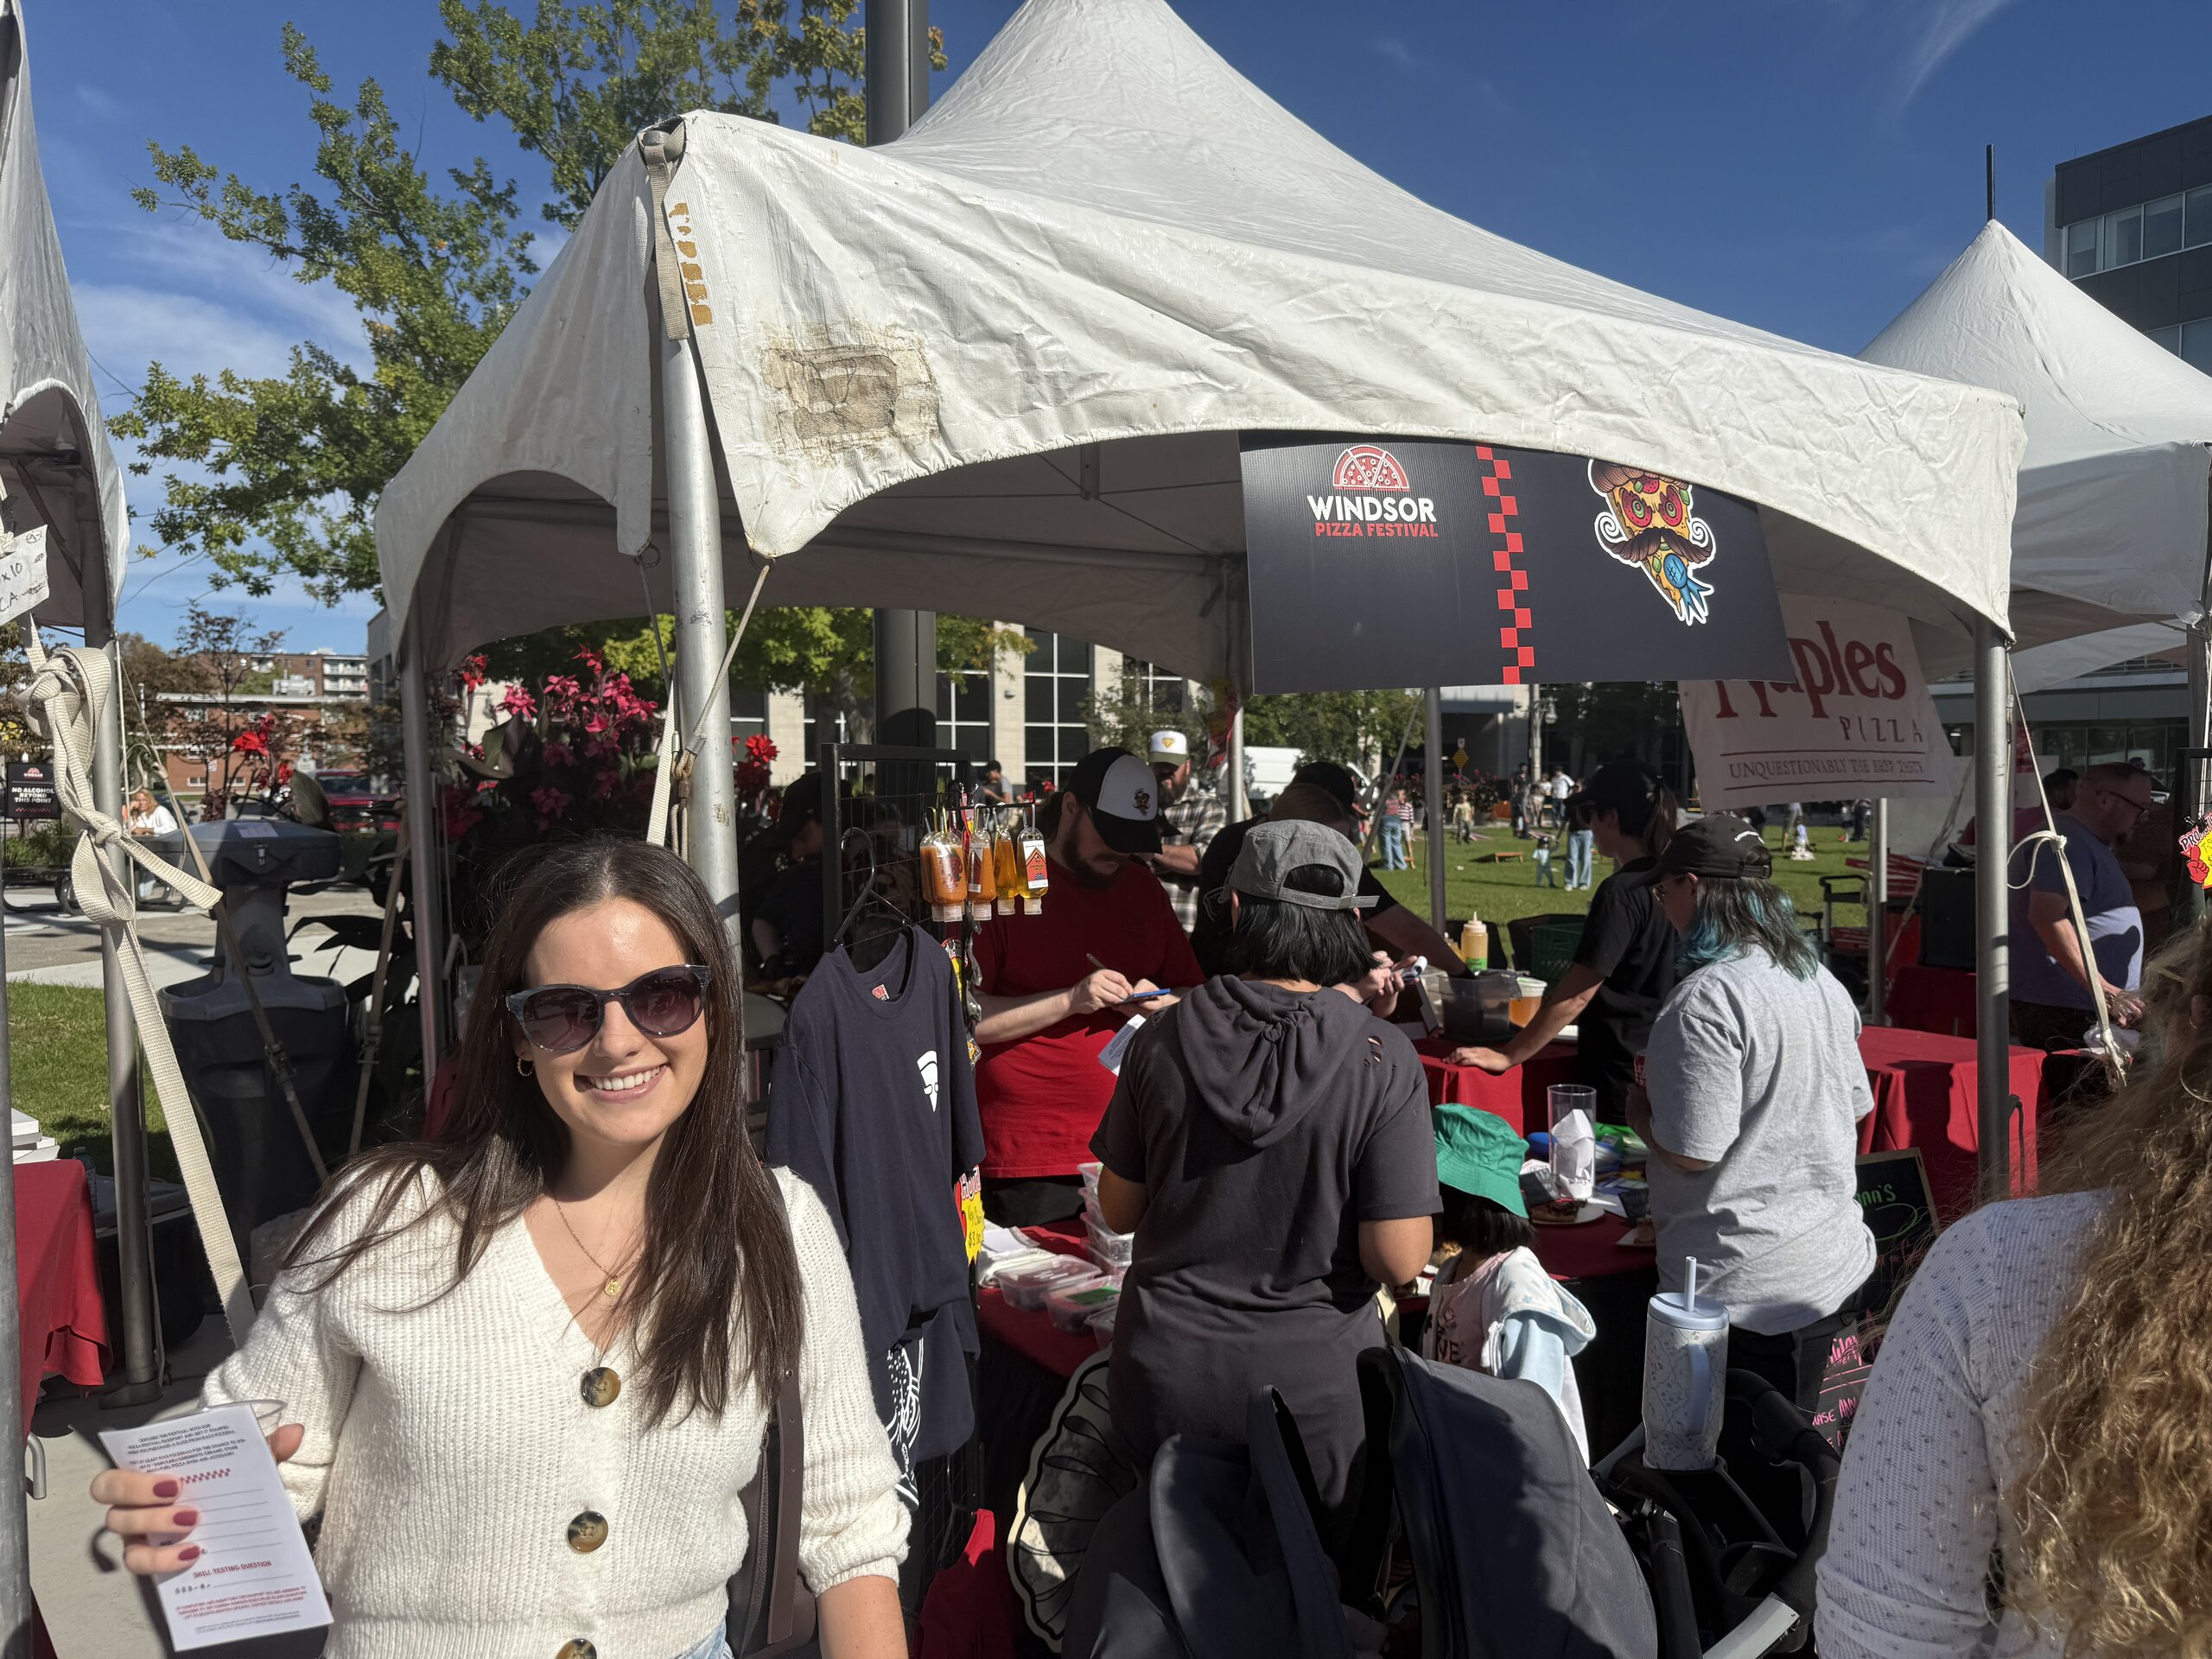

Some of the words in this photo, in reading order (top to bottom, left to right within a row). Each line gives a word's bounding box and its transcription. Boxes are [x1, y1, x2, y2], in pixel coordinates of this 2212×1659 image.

[1306, 495, 1437, 523] WINDSOR
[1315, 522, 1363, 537] PIZZA
[1367, 523, 1439, 537] FESTIVAL
[1716, 620, 1907, 719] ples
[1840, 715, 1923, 742] PIZZA
[1729, 759, 1847, 780] UNQUESTIONABLY
[212, 1565, 240, 1575] TESTING
[240, 1560, 273, 1571] QUESTION
